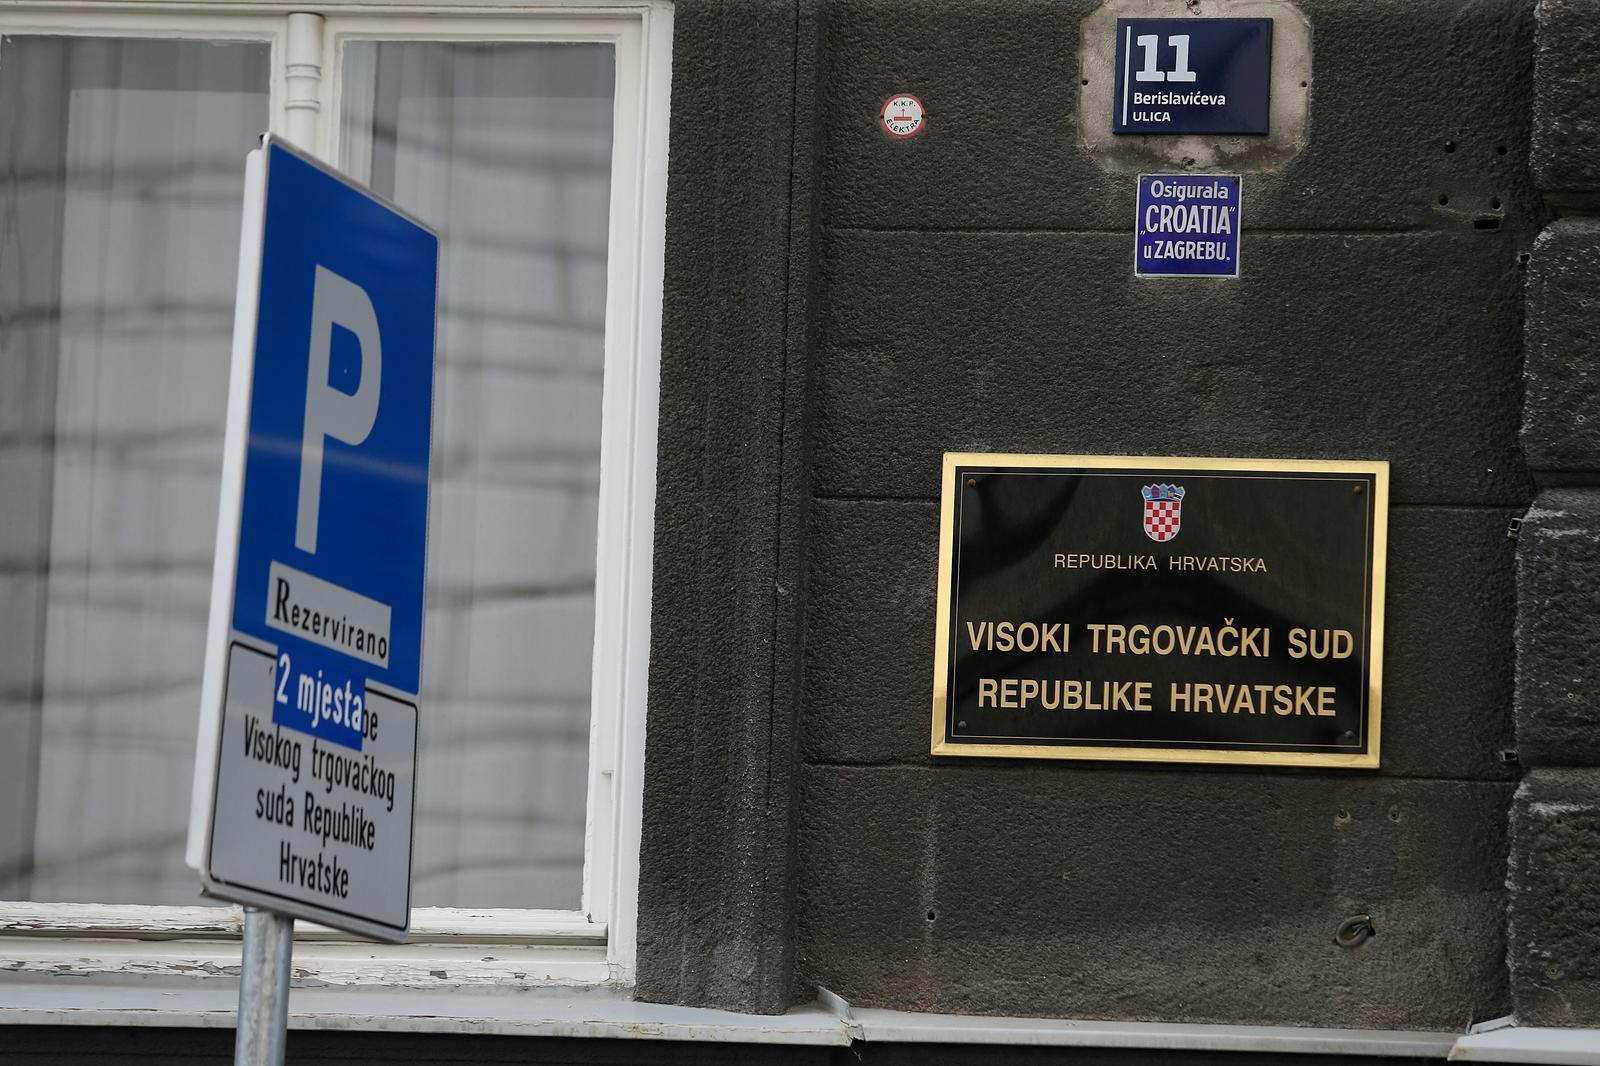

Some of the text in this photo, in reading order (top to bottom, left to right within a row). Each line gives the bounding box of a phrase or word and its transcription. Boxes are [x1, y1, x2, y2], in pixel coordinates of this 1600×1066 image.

[1135, 34, 1197, 83] 11
[1132, 111, 1171, 123] ULICA
[1133, 91, 1226, 106] Berislavićeva
[886, 118, 920, 133] ELEKTRA
[1150, 180, 1229, 202] Osigurala
[1143, 240, 1231, 261] u ZAGREBU.
[294, 263, 383, 556] P
[1053, 553, 1268, 573] REPUBLIKA HRVATSKA
[273, 576, 388, 660] Rezervirano
[966, 617, 1355, 660] VISOKI TRGOVAČKI SUD
[276, 652, 292, 705] 2
[296, 669, 363, 733] mjesta
[977, 678, 1337, 717] REPUBLIKE HRVATSKE
[243, 713, 302, 784] Visokog
[311, 738, 396, 813] trgovačkog
[255, 784, 376, 852] suda Republike
[279, 841, 349, 899] Hrvatske
